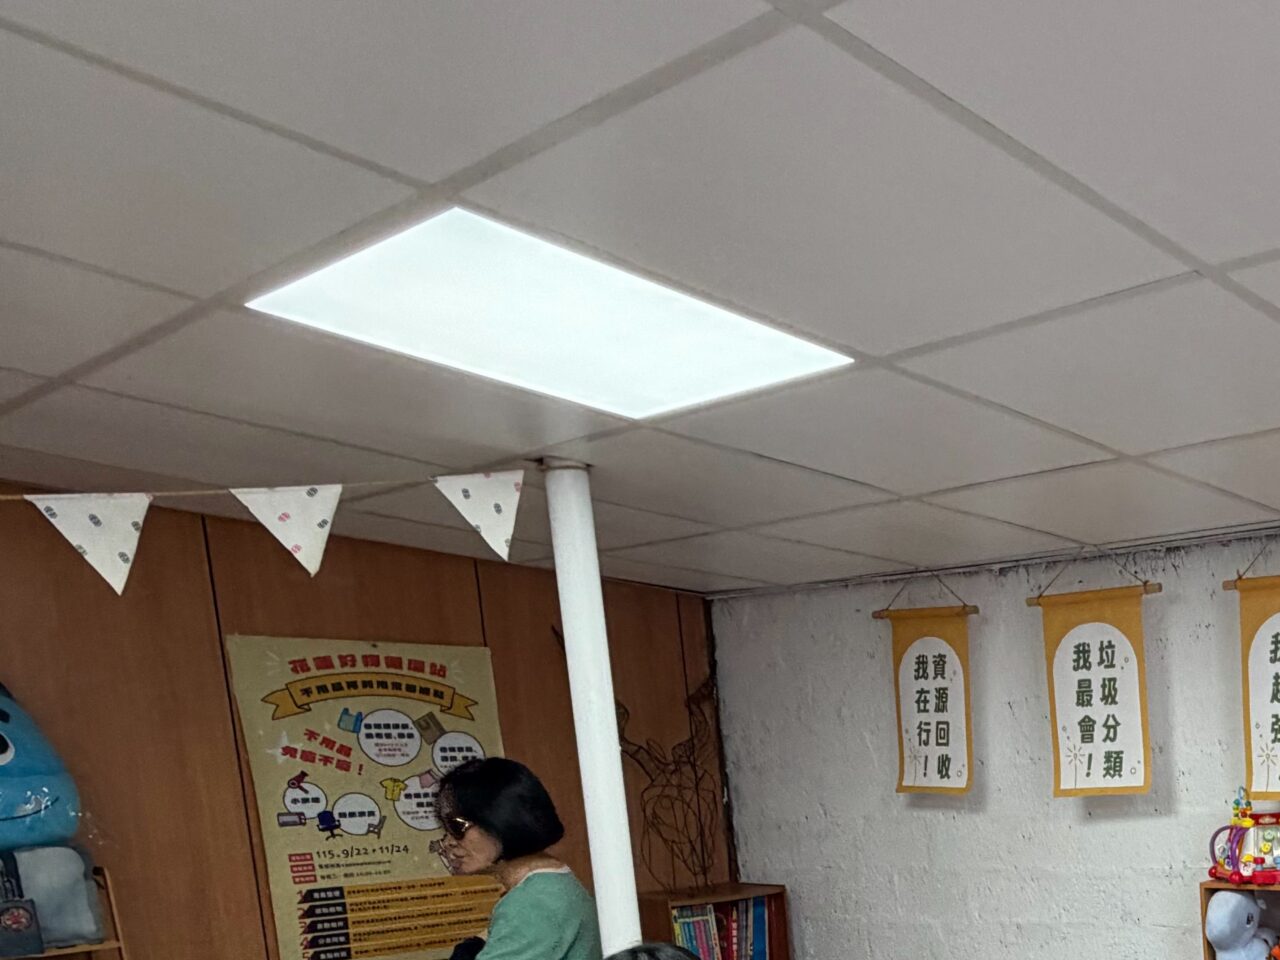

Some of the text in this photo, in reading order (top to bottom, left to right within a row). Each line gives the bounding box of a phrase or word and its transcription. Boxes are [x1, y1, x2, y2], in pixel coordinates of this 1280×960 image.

[914, 653, 931, 778] 我在行！
[931, 652, 951, 781] 資源回收
[1072, 642, 1096, 778] 我最會！
[1097, 640, 1124, 779] 垃圾分類
